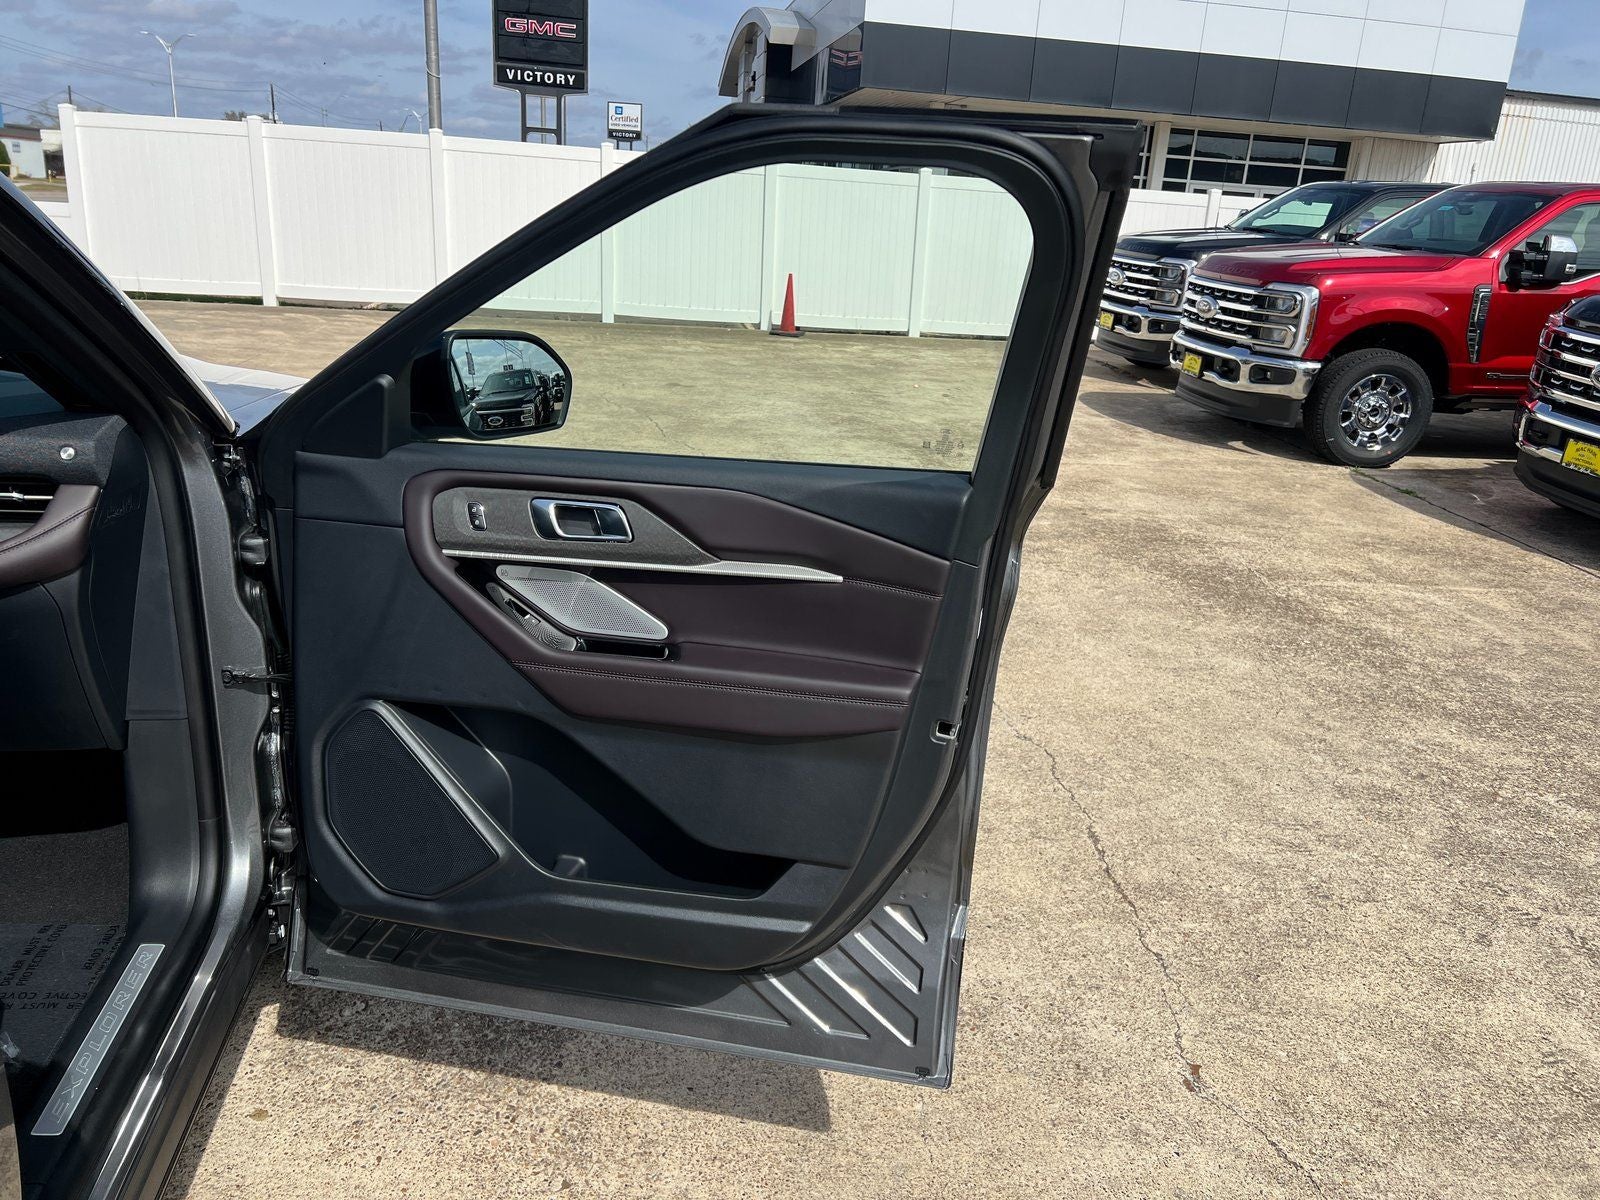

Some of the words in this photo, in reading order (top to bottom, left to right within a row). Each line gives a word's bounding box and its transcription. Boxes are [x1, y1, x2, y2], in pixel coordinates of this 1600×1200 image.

[504, 17, 577, 39] GMC
[506, 68, 576, 86] VICTORY
[610, 115, 639, 123] Certified
[52, 951, 154, 1124] EXPLORER
